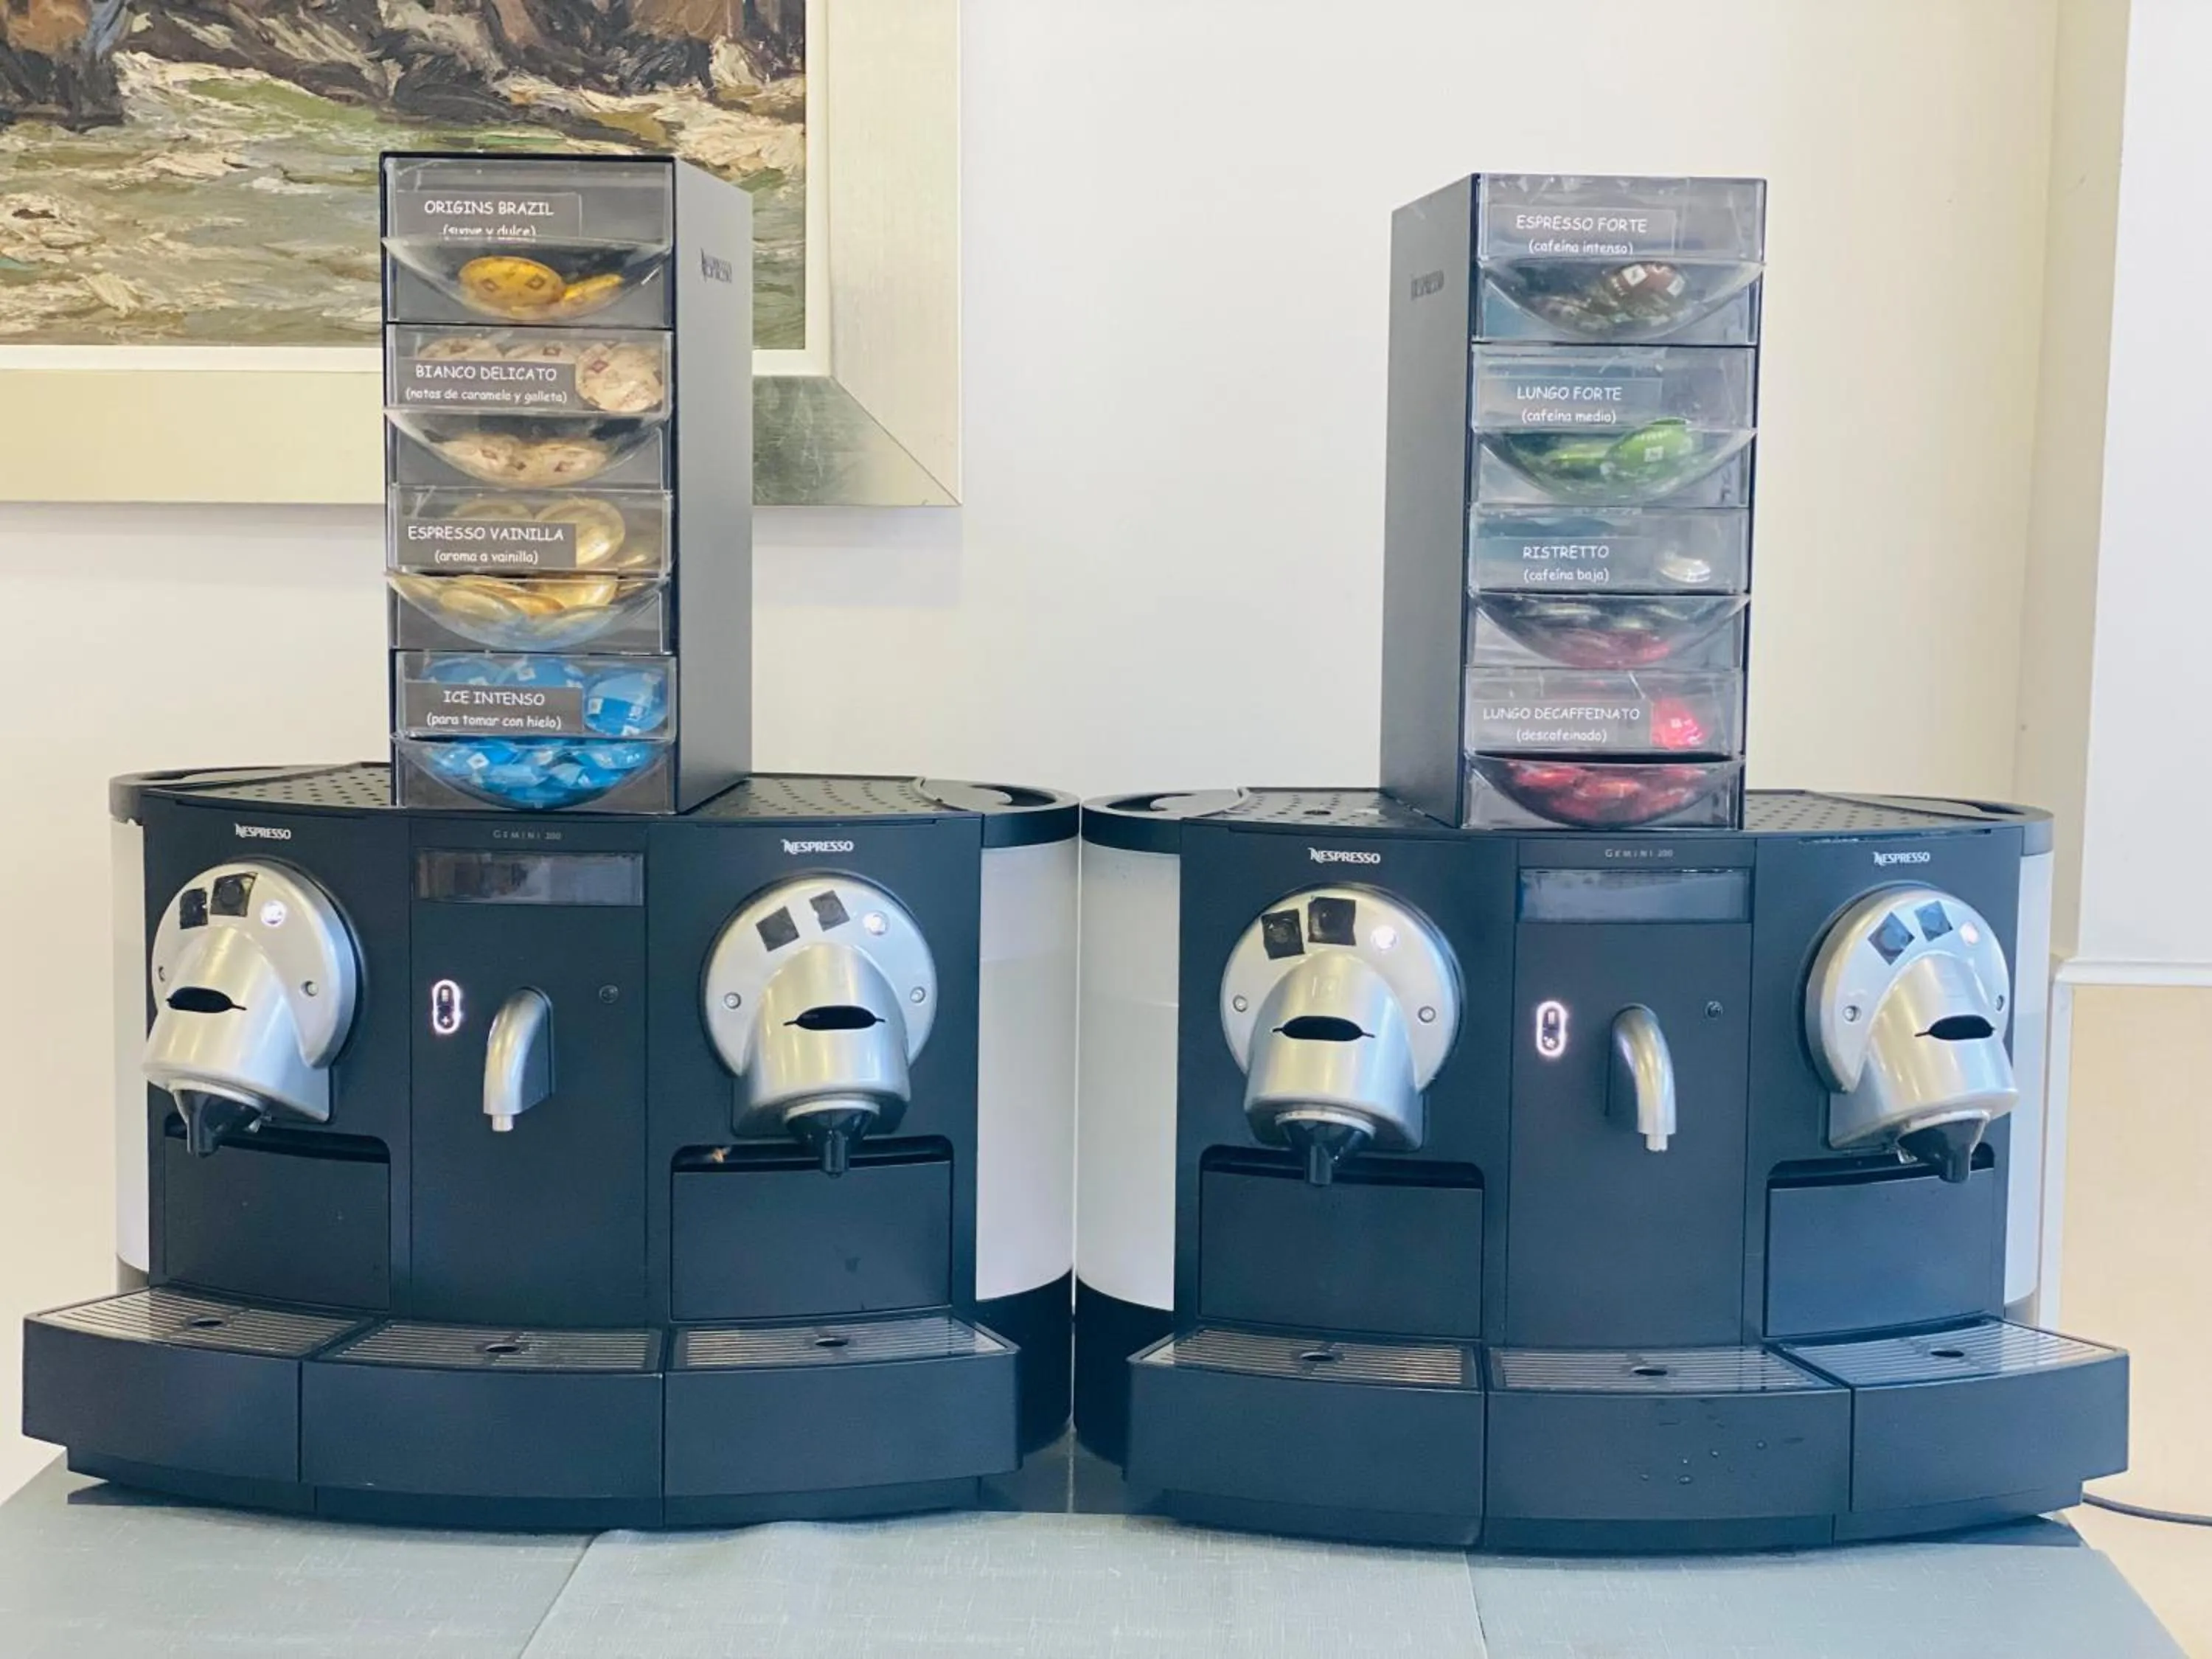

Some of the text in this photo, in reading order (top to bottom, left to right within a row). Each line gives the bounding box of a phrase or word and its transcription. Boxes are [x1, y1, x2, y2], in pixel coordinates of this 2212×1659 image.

[424, 200, 554, 216] ORIGINS BRAZIL
[1515, 214, 1649, 233] ESPRESSO FORTE
[415, 364, 557, 381] BIANCO DELICATO
[444, 387, 459, 400] de
[514, 392, 521, 404] y
[524, 390, 567, 405] galleta)
[1516, 385, 1623, 402] LUNGO FORTE
[407, 525, 564, 542] ESPRESSO VAINILLA
[434, 549, 477, 564] (aroma
[479, 553, 487, 563] a
[1522, 545, 1610, 560] RISTRETTO
[1576, 567, 1610, 583] baja)
[442, 690, 546, 706] ICE INTENSO
[426, 712, 562, 731] (para tomar con hielo)
[1483, 706, 1641, 721] LUNGO DECAFFEINATO
[234, 823, 292, 840] NESPRESSO
[780, 838, 855, 855] NESPRESSO
[1307, 846, 1381, 864] NESPRESSO
[1872, 851, 1931, 867] NESPRESSO
